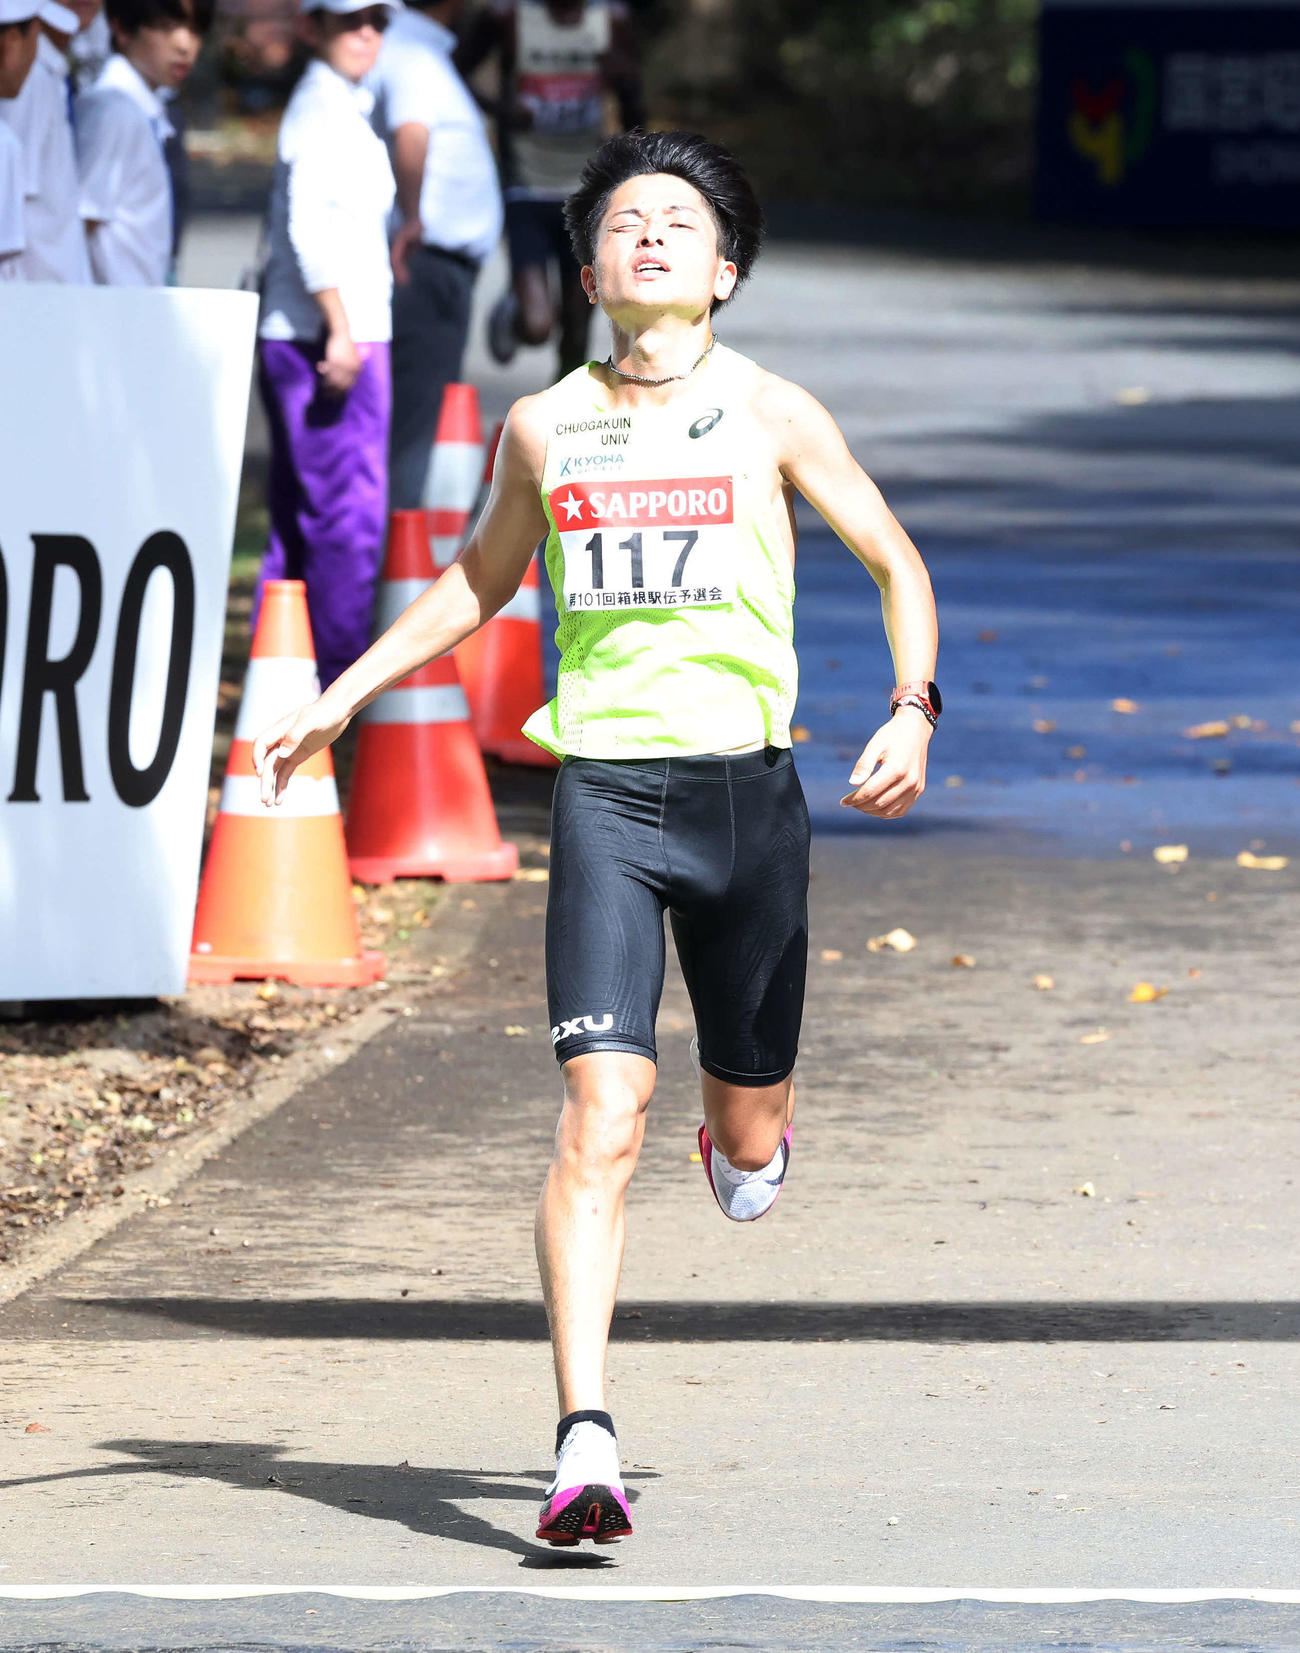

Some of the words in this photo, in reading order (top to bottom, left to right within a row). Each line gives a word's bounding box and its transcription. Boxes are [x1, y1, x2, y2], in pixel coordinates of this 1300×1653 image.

[555, 416, 631, 436] CHUOGAKUIN
[601, 433, 630, 446] UNIV
[574, 453, 625, 467] KYOWA
[589, 487, 728, 519] SAPPORO
[585, 530, 699, 589] 117
[0, 530, 195, 807] RO
[551, 1013, 614, 1047] 2XU
